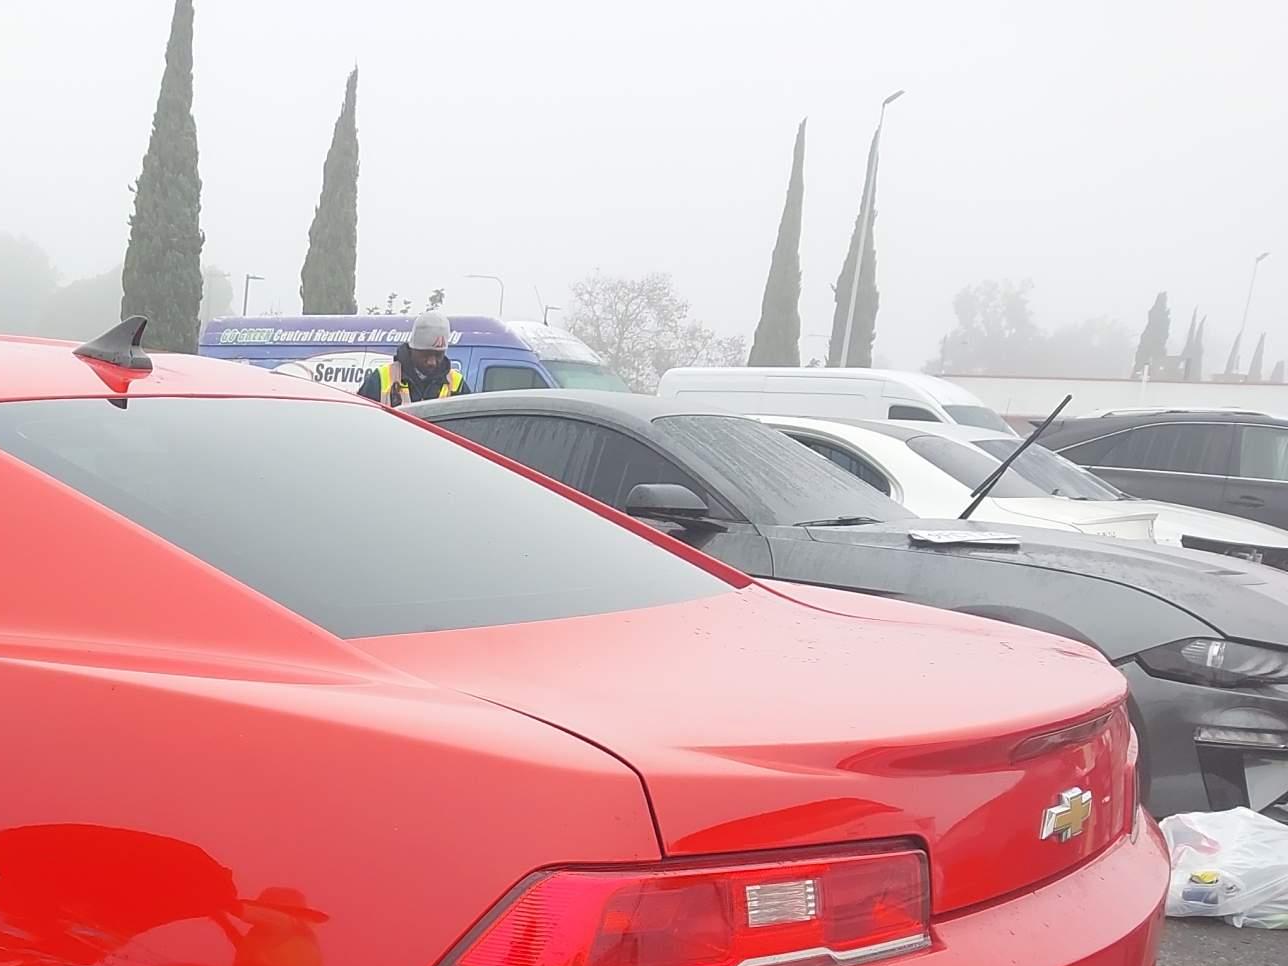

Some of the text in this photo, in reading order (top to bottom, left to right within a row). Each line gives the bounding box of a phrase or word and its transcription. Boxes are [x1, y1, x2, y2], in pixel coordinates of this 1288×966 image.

[273, 328, 315, 342] Central
[313, 328, 357, 343] Heating
[357, 330, 368, 342] &
[368, 328, 387, 342] Air
